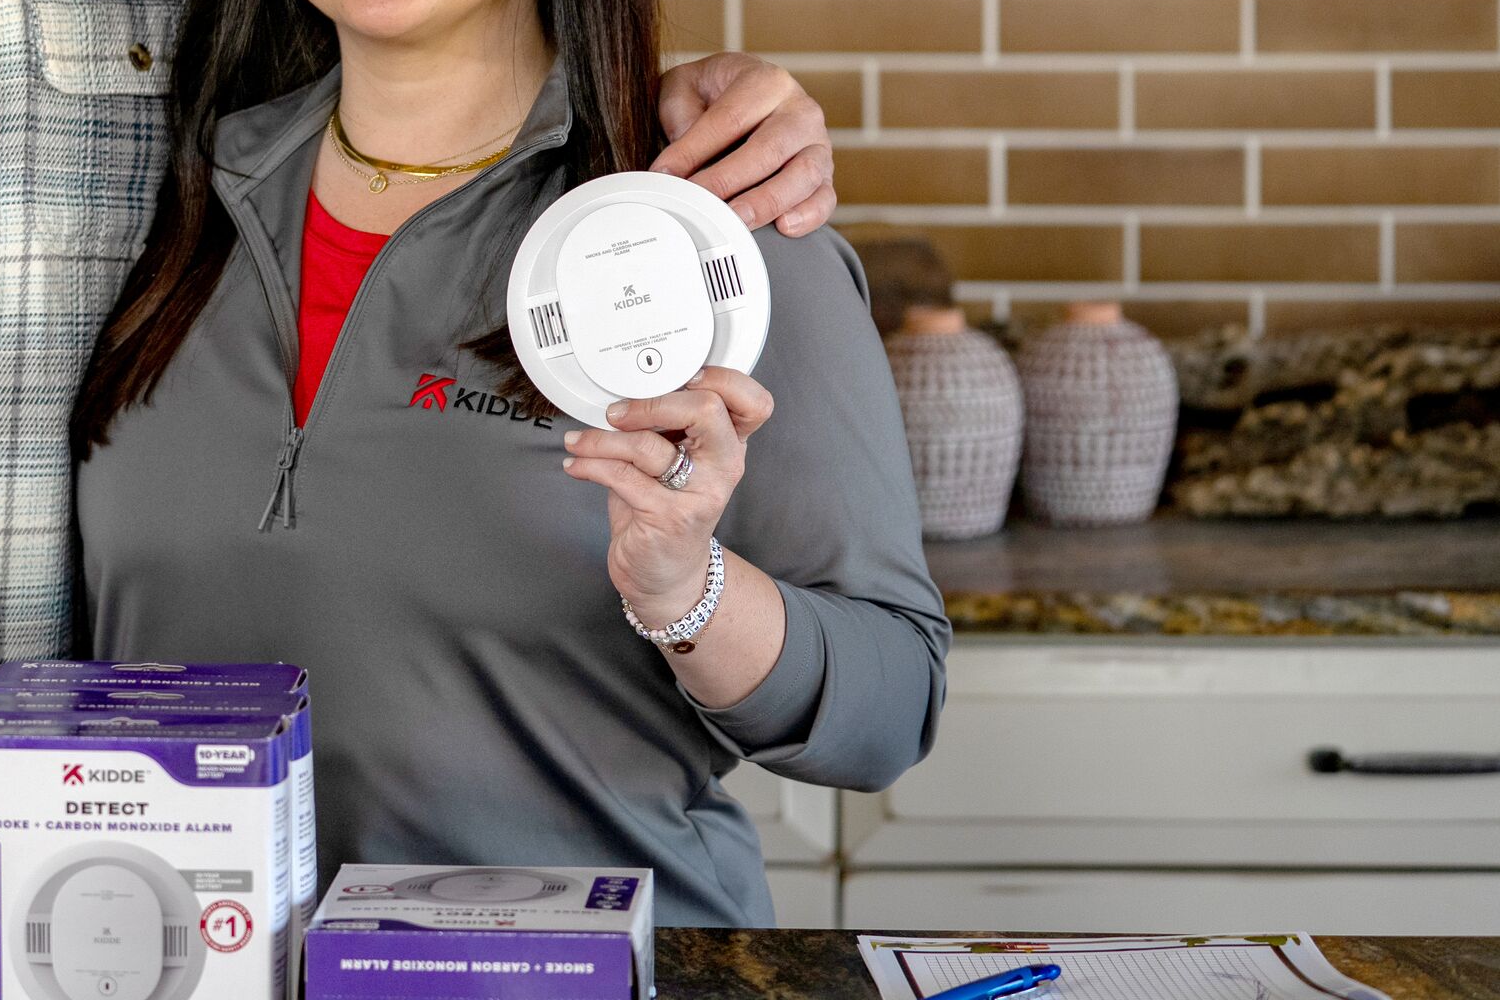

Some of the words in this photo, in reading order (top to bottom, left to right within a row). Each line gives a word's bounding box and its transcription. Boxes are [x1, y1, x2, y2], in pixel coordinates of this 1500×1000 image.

[614, 294, 651, 310] KIDDE
[199, 749, 246, 760] 10-YEAR
[88, 769, 146, 784] KIDDE
[65, 801, 150, 816] DETECT
[45, 820, 102, 831] CARBON
[107, 821, 181, 832] MONOXIDE
[185, 822, 233, 833] ALARM
[212, 915, 236, 938] #1
[340, 958, 389, 970] ALARM
[392, 959, 467, 972] MONOXIDE
[471, 961, 530, 973] CARBON
[545, 962, 594, 974] SMOKE
